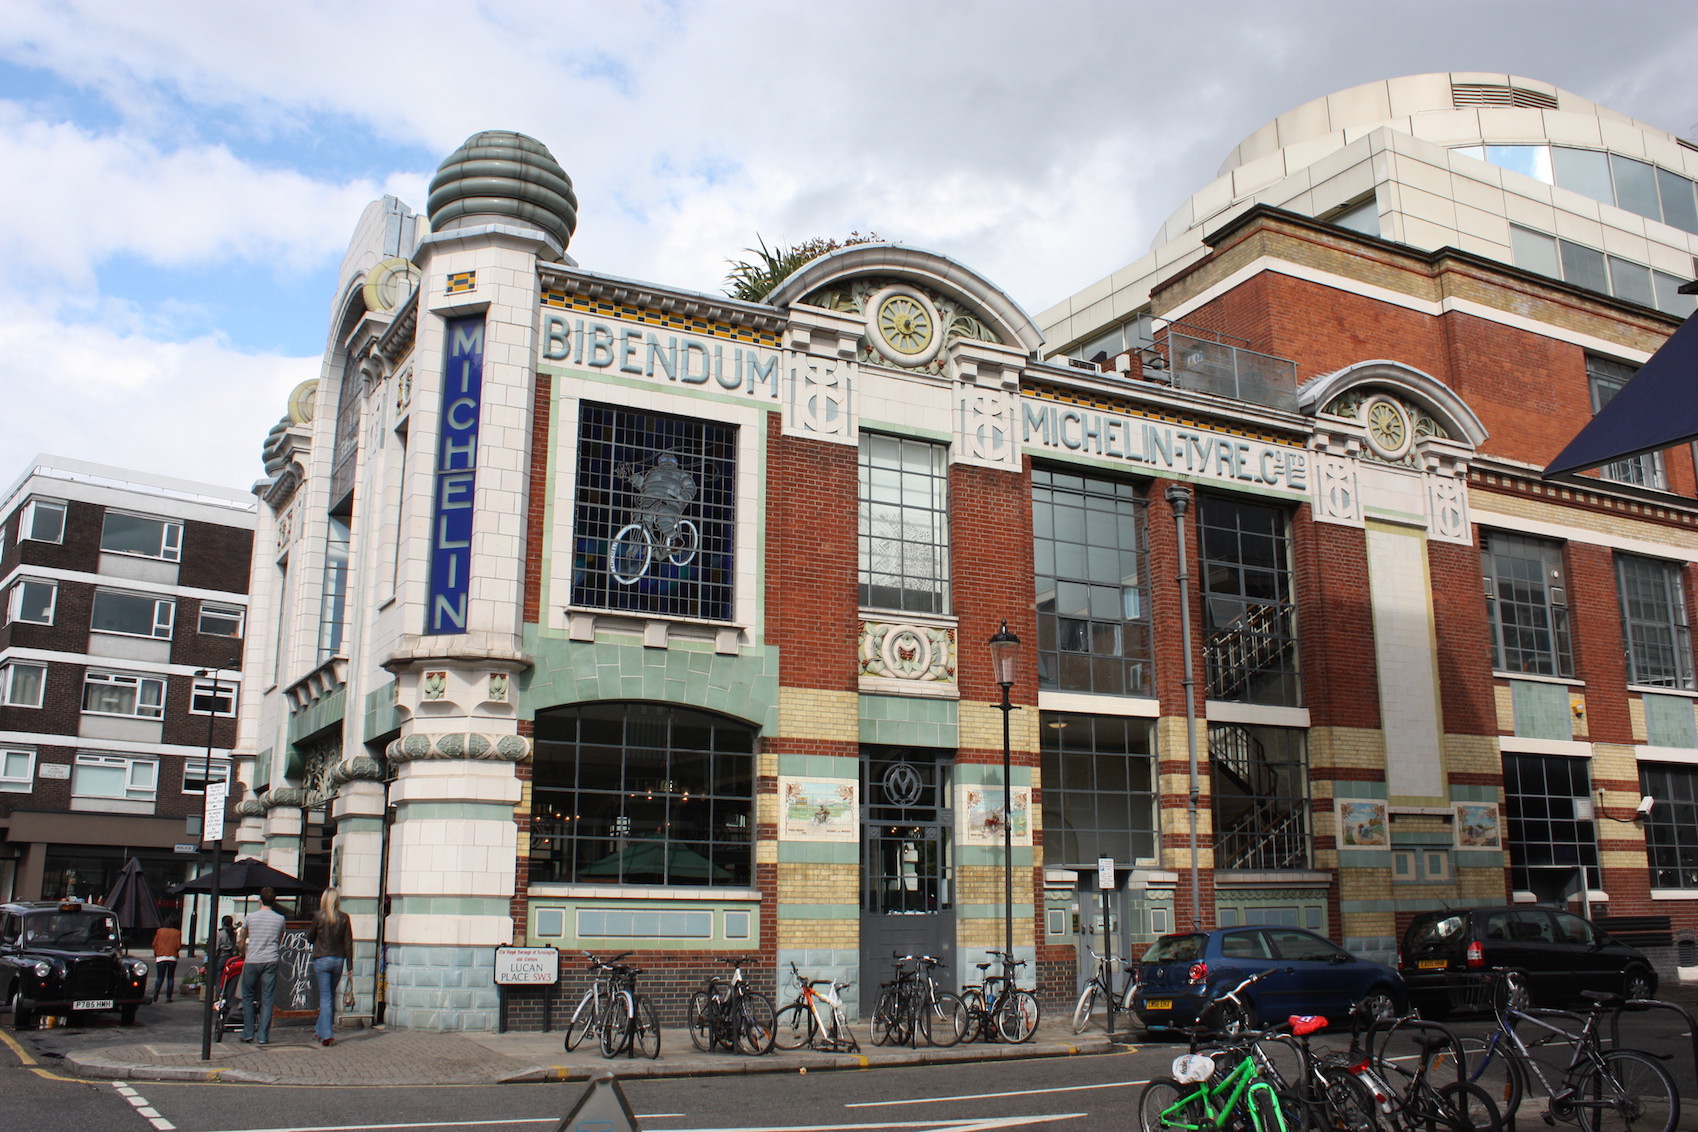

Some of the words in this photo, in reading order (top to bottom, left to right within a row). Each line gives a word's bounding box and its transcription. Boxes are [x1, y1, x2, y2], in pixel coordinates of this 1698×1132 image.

[542, 313, 779, 399] BIBENDUM
[433, 324, 485, 630] MICHELIN
[501, 973, 528, 981] PLACE
[510, 963, 543, 972] LUCAN
